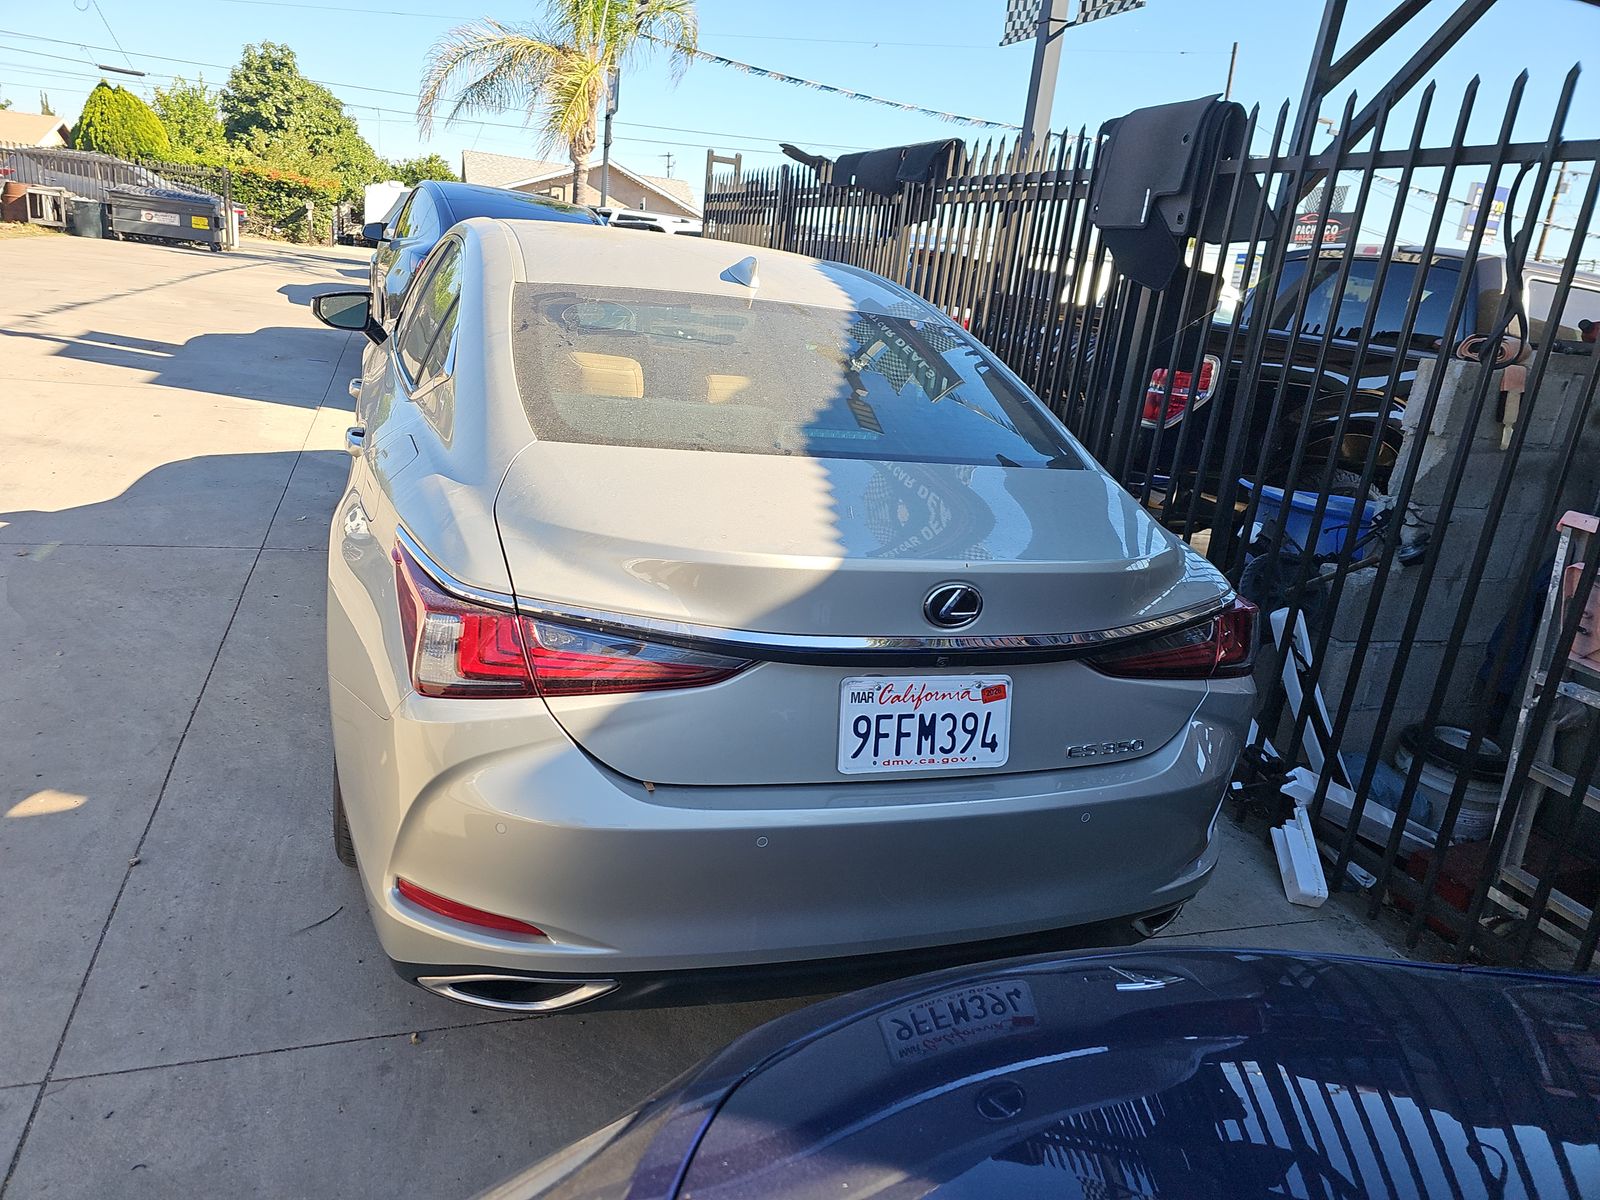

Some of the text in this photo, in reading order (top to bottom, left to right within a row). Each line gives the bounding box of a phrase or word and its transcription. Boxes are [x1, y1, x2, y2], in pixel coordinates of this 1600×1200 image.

[1295, 224, 1339, 235] PACHCO
[850, 691, 875, 704] MAR
[878, 683, 983, 711] California
[850, 711, 998, 759] 9FFM394
[1066, 739, 1144, 759] ES 350
[882, 756, 968, 767] dmv.ca.gov
